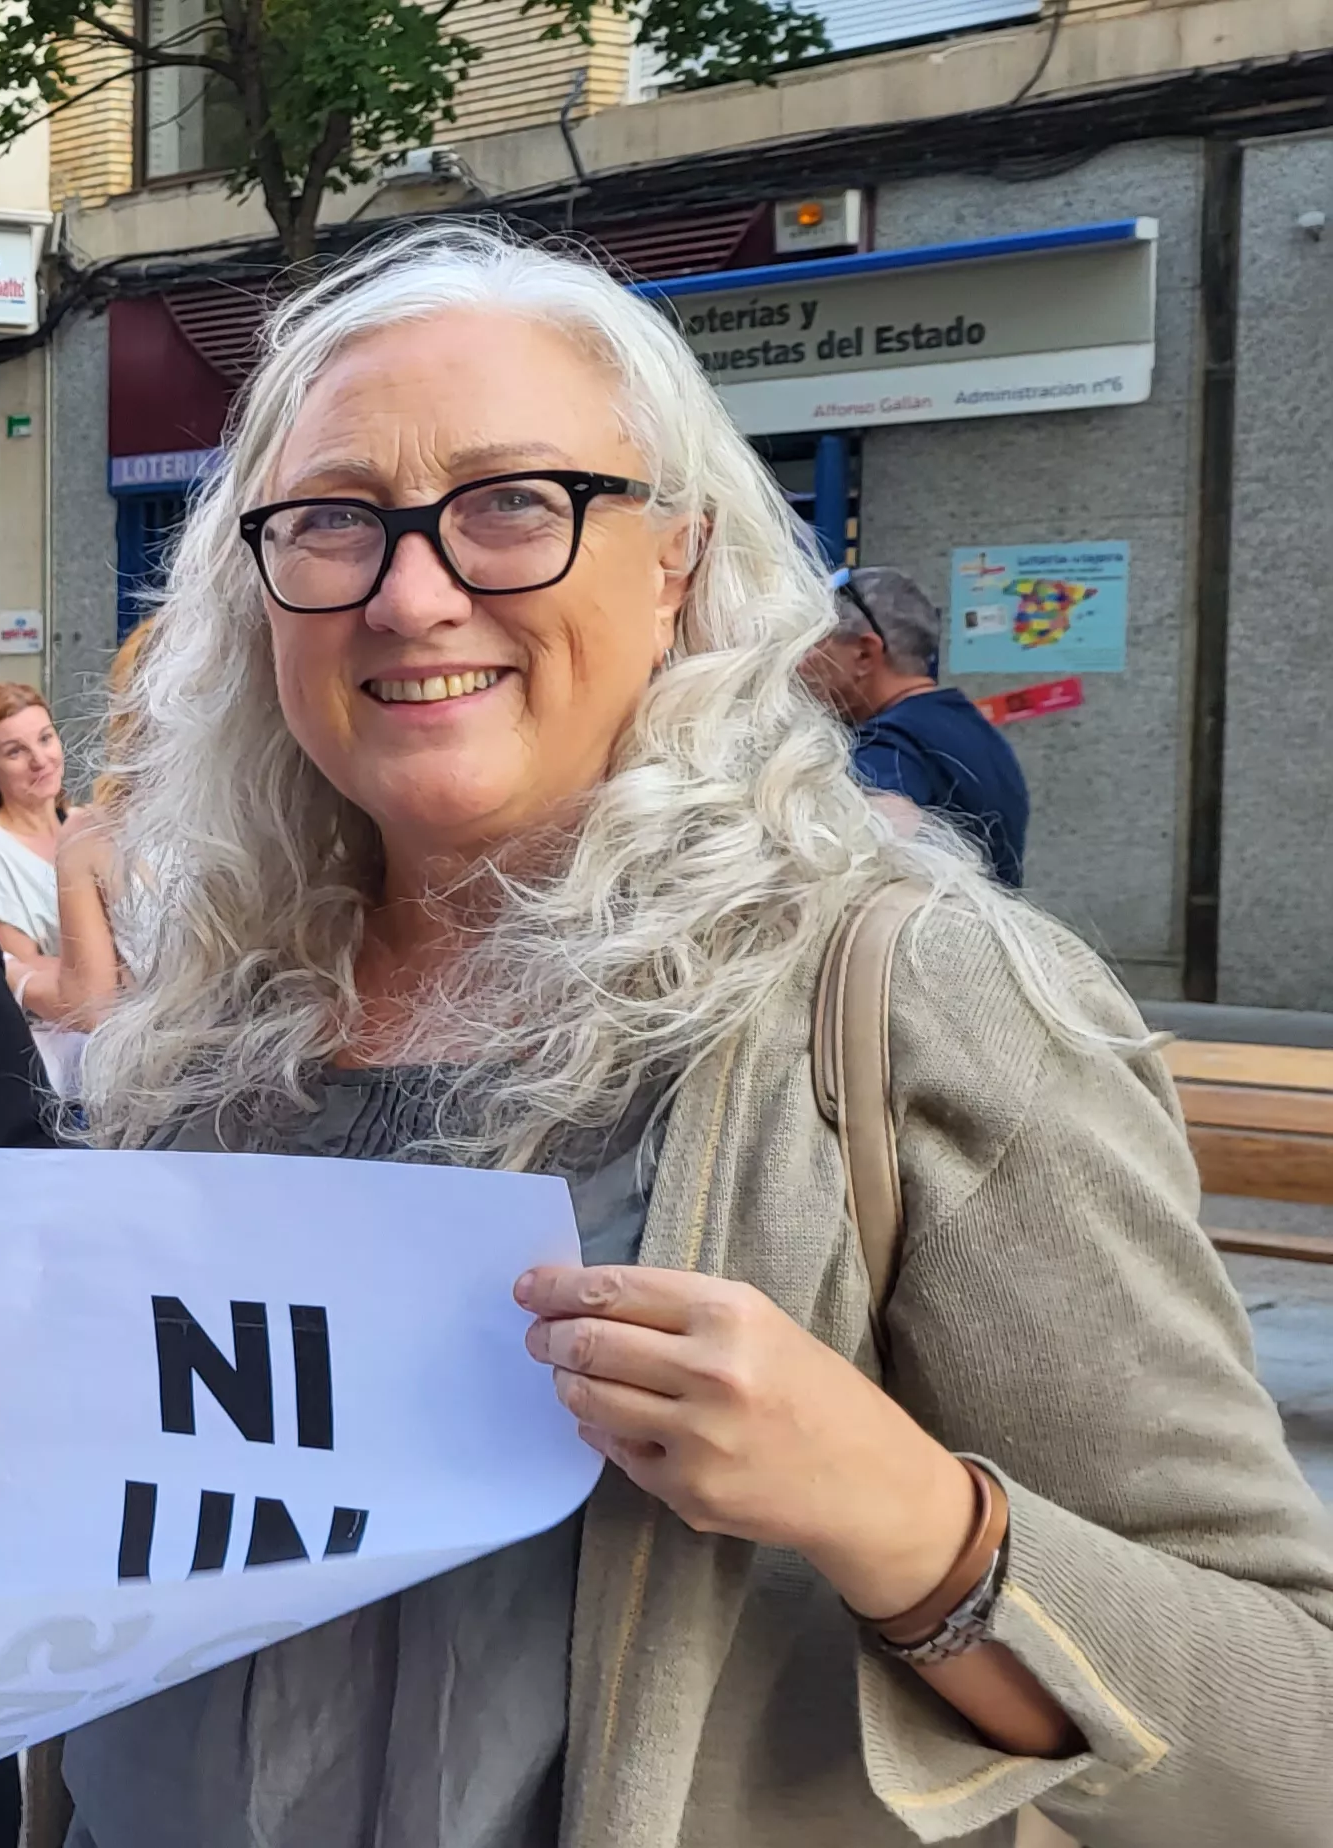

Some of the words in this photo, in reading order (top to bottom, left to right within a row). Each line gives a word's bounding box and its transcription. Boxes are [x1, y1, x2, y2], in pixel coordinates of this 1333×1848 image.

[688, 297, 791, 336] oterías
[800, 299, 819, 332] y
[817, 325, 863, 361] del
[875, 314, 986, 356] Estado
[150, 1295, 334, 1451] NI
